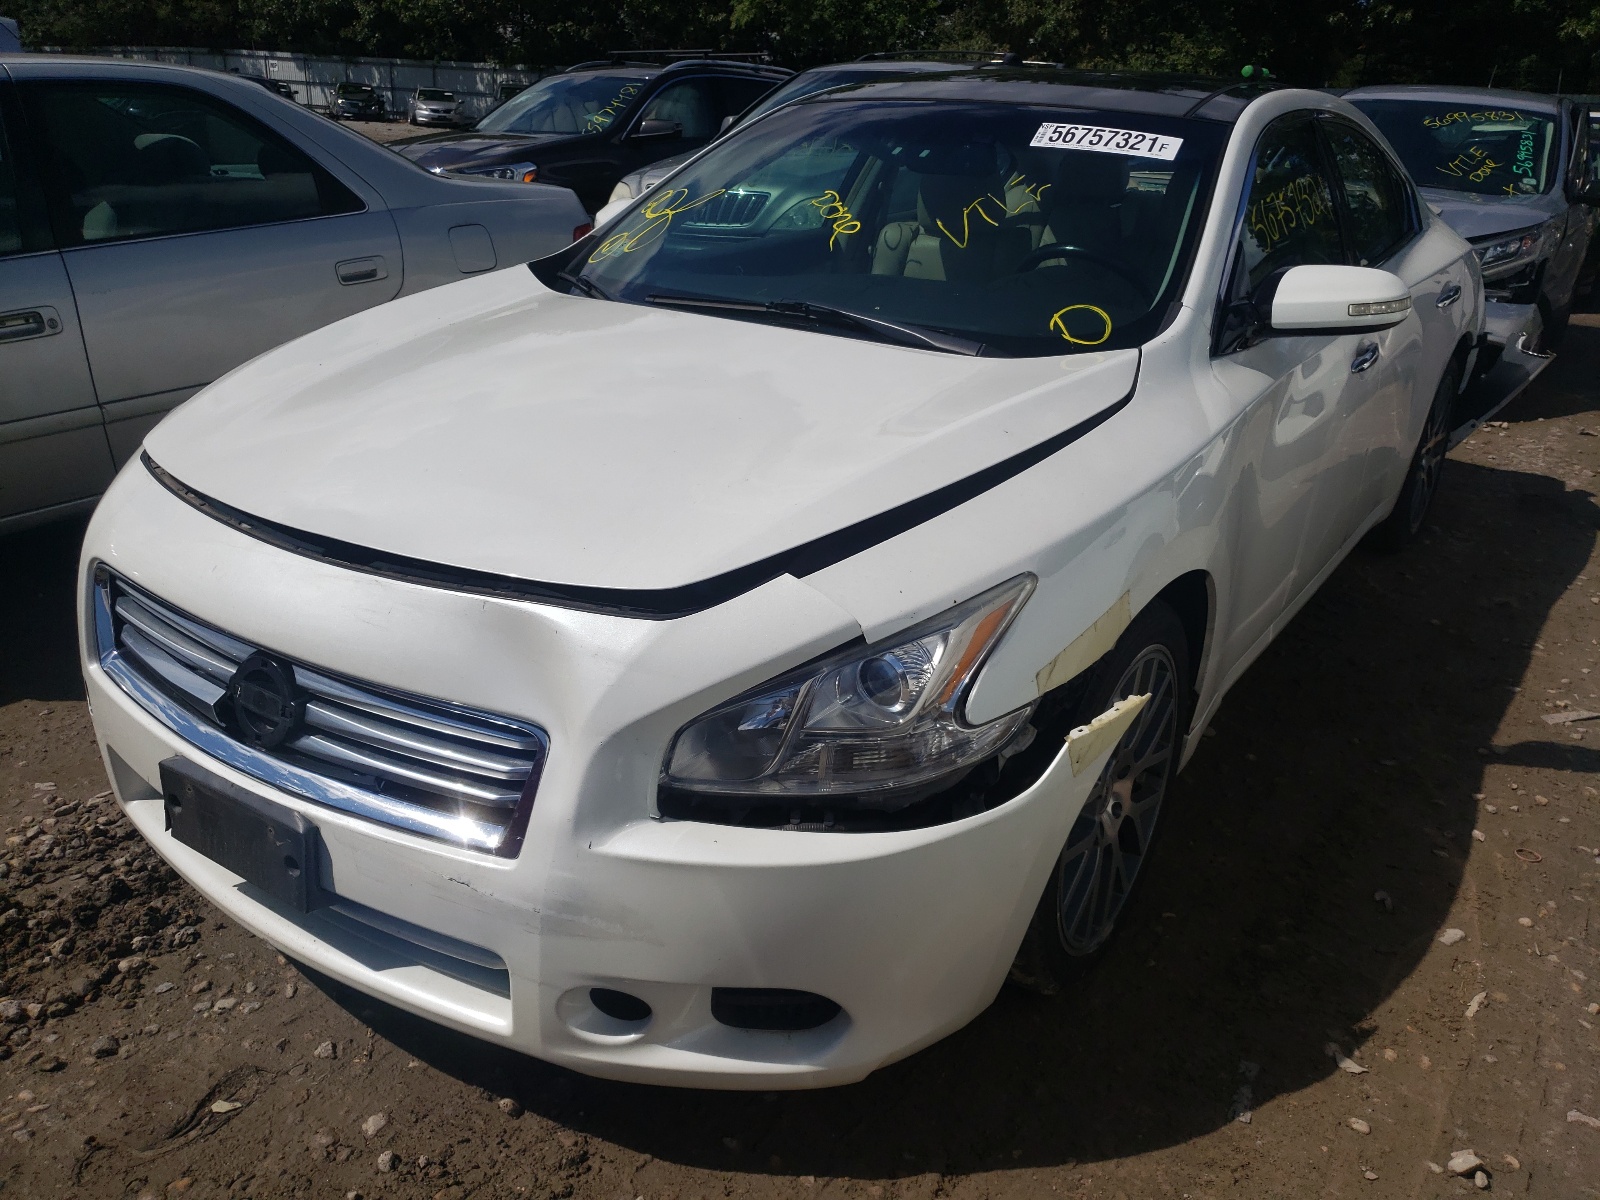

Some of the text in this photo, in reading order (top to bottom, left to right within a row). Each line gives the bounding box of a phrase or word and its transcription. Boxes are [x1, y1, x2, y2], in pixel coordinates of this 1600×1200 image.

[1423, 110, 1524, 129] 56995831
[1048, 125, 1159, 152] 56757321
[1158, 143, 1170, 152] F
[1436, 145, 1488, 177] VTLE
